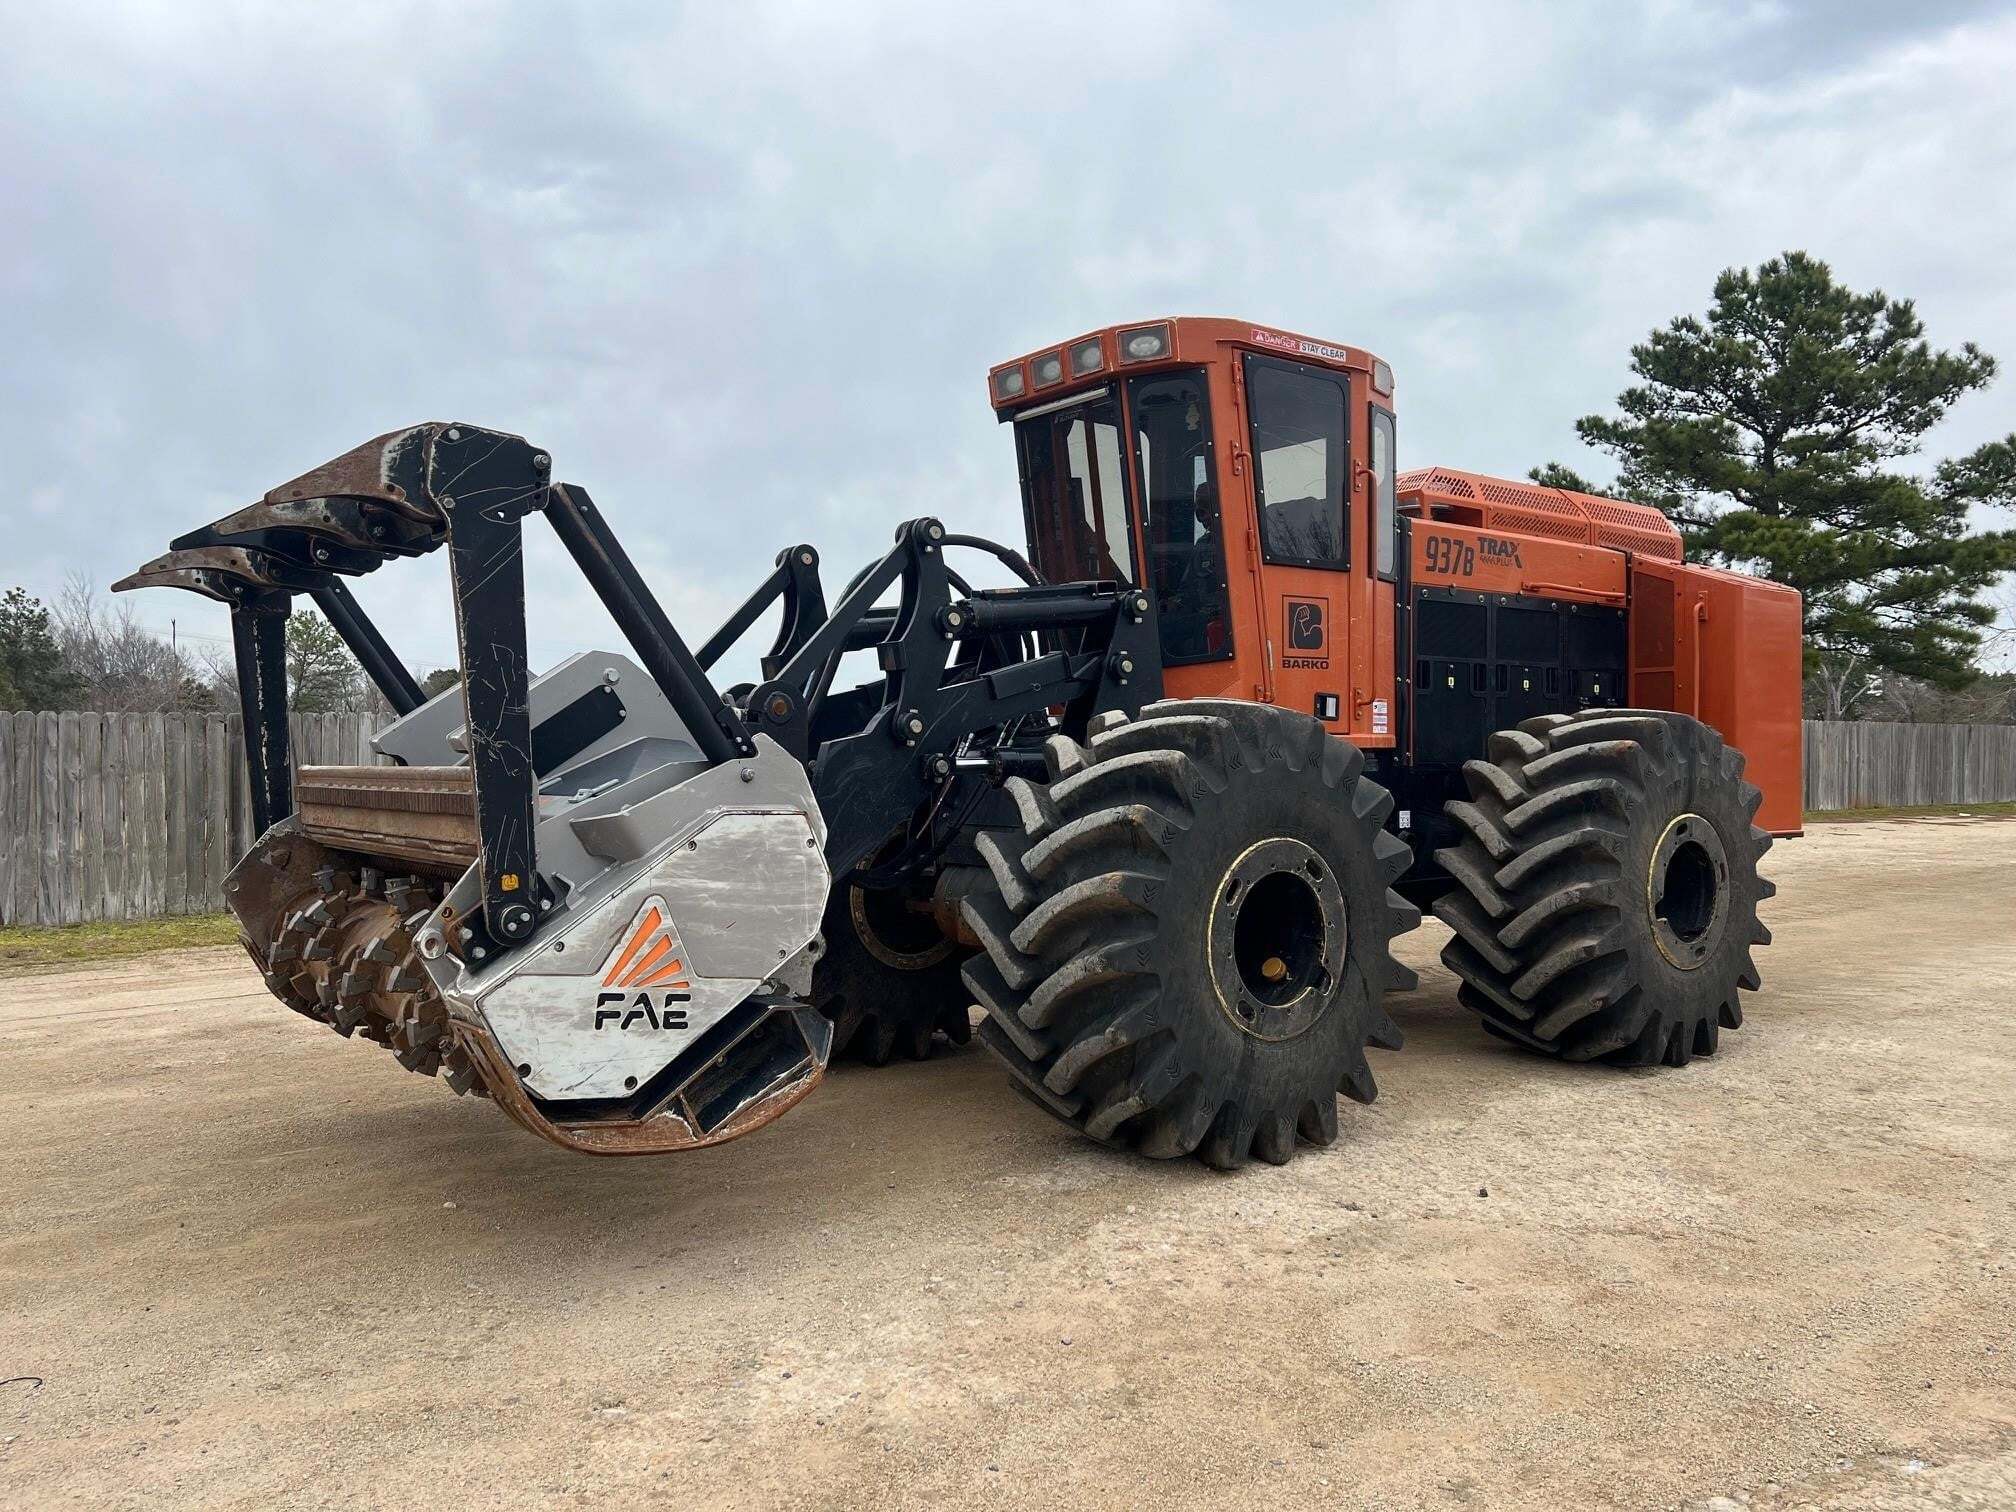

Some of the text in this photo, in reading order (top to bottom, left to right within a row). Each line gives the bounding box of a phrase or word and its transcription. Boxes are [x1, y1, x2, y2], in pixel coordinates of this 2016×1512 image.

[1264, 333, 1345, 360] DANGER STAY CLEAR
[1477, 536, 1523, 569] TRAX
[1282, 659, 1330, 670] BARKO
[594, 992, 692, 1031] FAE
